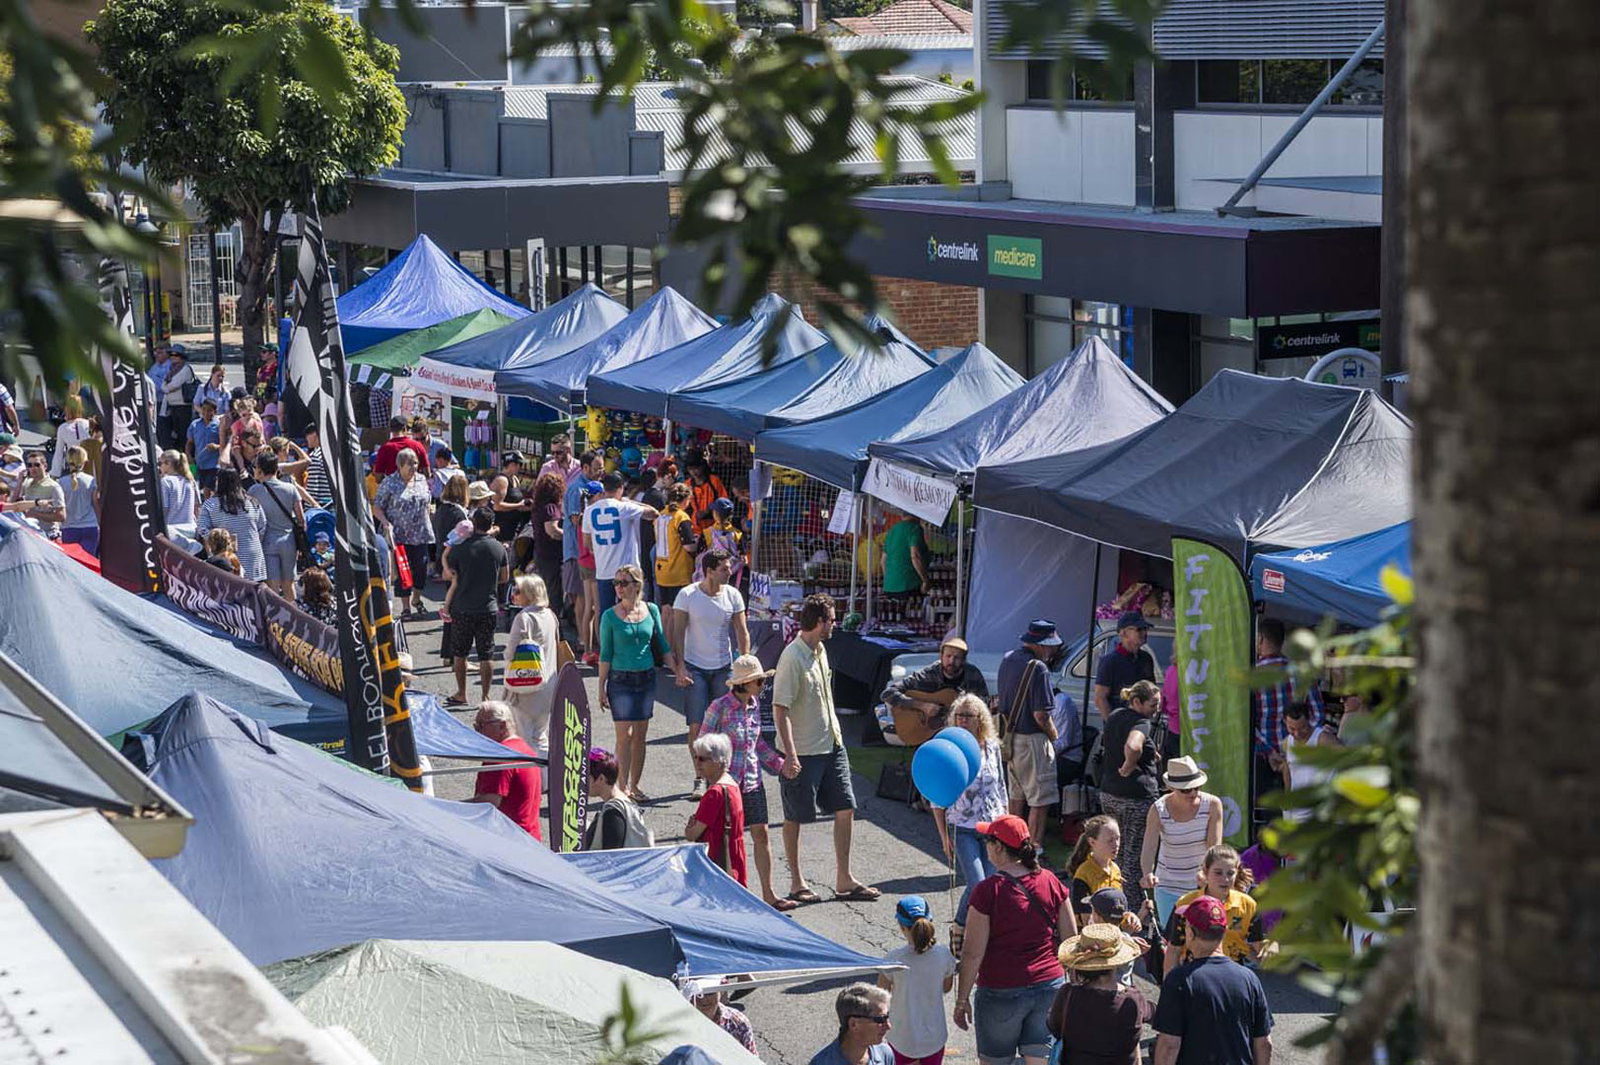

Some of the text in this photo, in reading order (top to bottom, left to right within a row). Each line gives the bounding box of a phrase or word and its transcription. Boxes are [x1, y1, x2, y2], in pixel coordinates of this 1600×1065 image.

[937, 242, 979, 261] centrelink
[994, 246, 1037, 269] medicare
[1287, 332, 1341, 347] centrelink
[1185, 554, 1212, 769] FITNES
